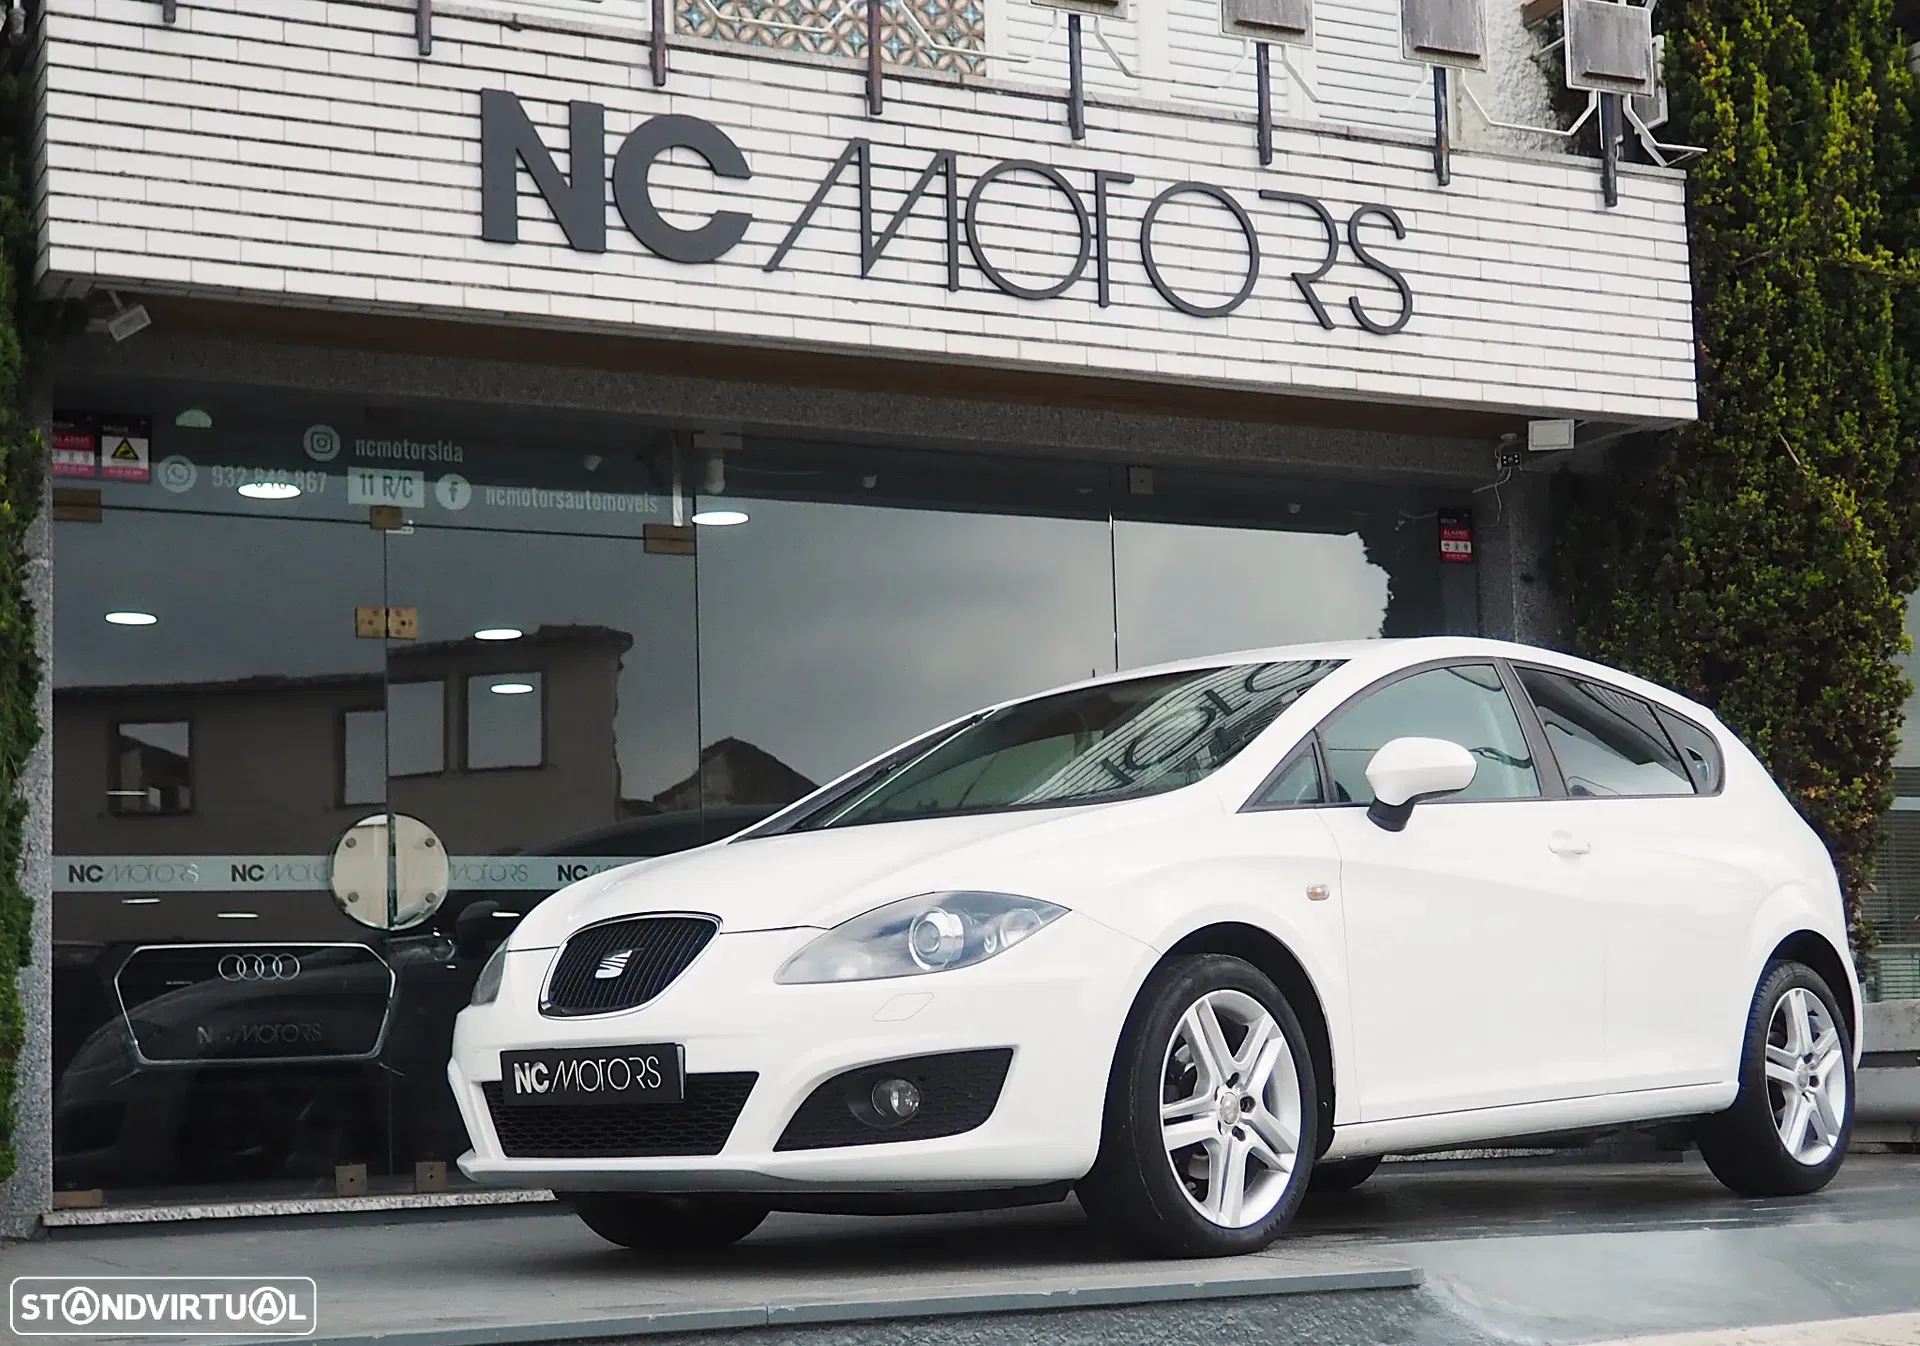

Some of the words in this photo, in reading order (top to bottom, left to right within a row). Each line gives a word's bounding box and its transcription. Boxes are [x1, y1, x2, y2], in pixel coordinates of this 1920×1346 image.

[480, 88, 752, 264] NC
[763, 137, 1413, 336] MOTORS
[355, 438, 464, 463] ncmotorslda
[383, 474, 413, 500] R/C
[68, 863, 104, 883] NC
[103, 863, 199, 884] MOTORS
[231, 864, 264, 882] NC
[514, 1061, 549, 1094] NC
[551, 1056, 661, 1093] MOTORS
